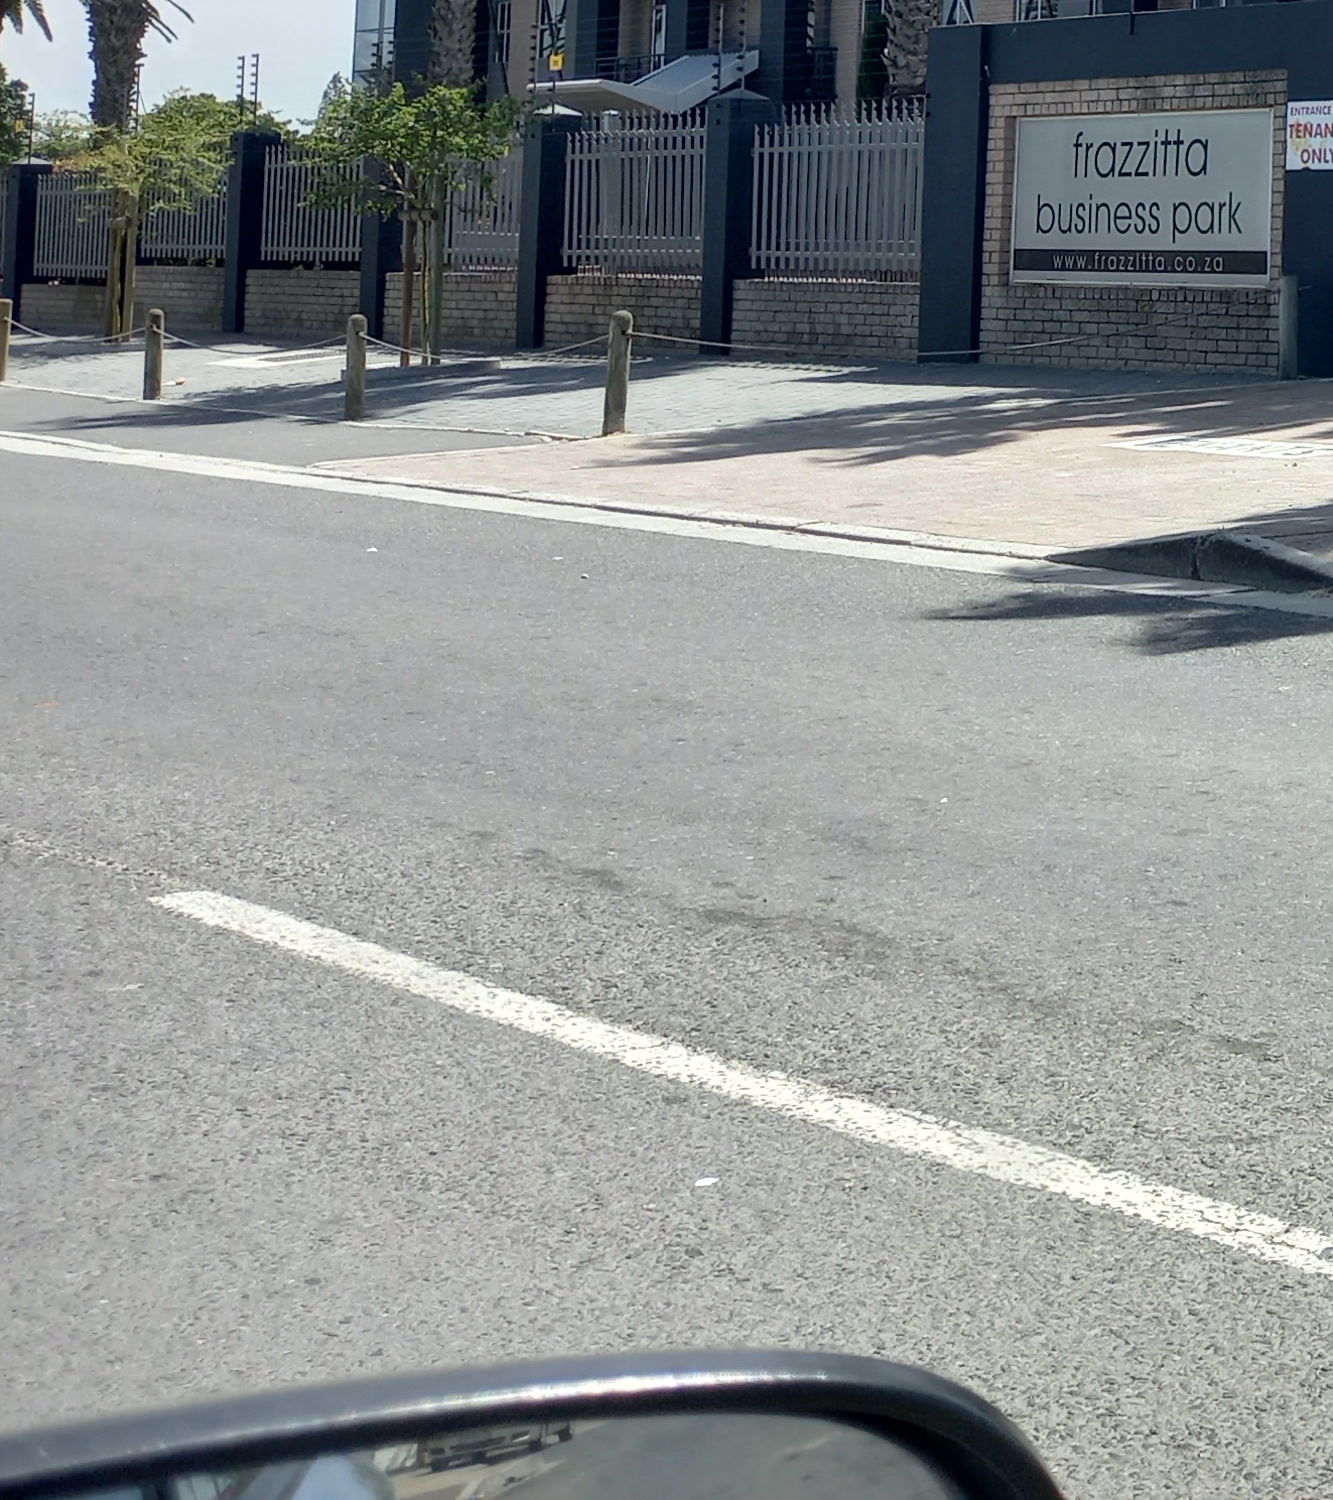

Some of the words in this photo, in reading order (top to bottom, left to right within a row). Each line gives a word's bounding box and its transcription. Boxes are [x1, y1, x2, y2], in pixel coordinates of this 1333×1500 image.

[1290, 105, 1332, 116] ENTRANCE
[1073, 128, 1209, 178] frazzitta
[1035, 193, 1161, 235] business
[1171, 191, 1243, 244] park
[1053, 251, 1224, 272] www.frazzitta.co.za
